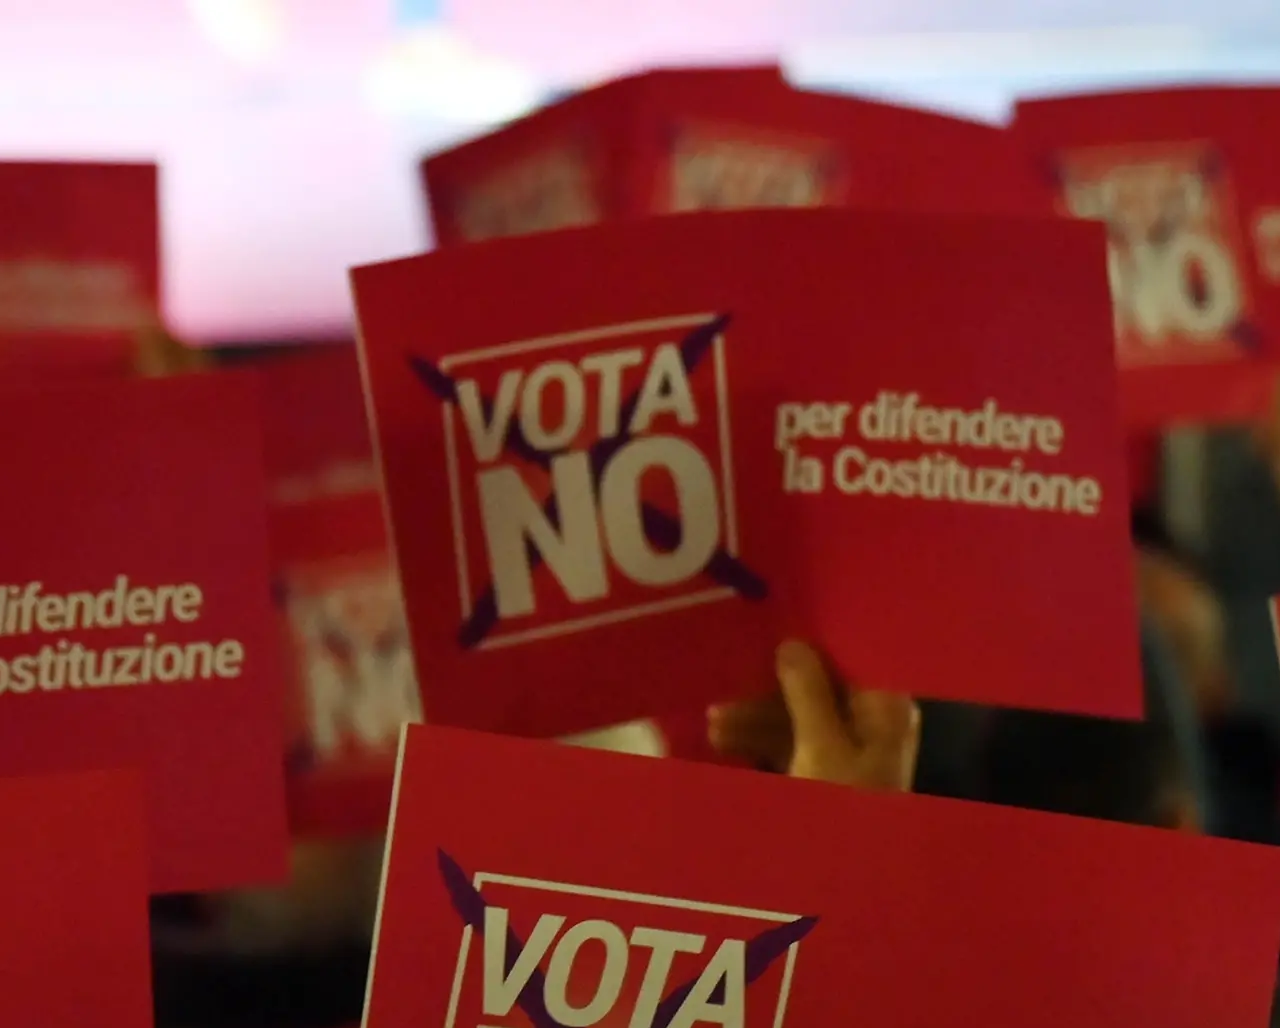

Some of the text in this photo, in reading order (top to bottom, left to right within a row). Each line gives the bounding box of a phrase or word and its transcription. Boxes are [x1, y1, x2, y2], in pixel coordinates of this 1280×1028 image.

[456, 342, 698, 463] VOTA
[777, 391, 1063, 467] per difendere
[477, 434, 720, 620] NO
[783, 447, 1101, 515] la Costituzione
